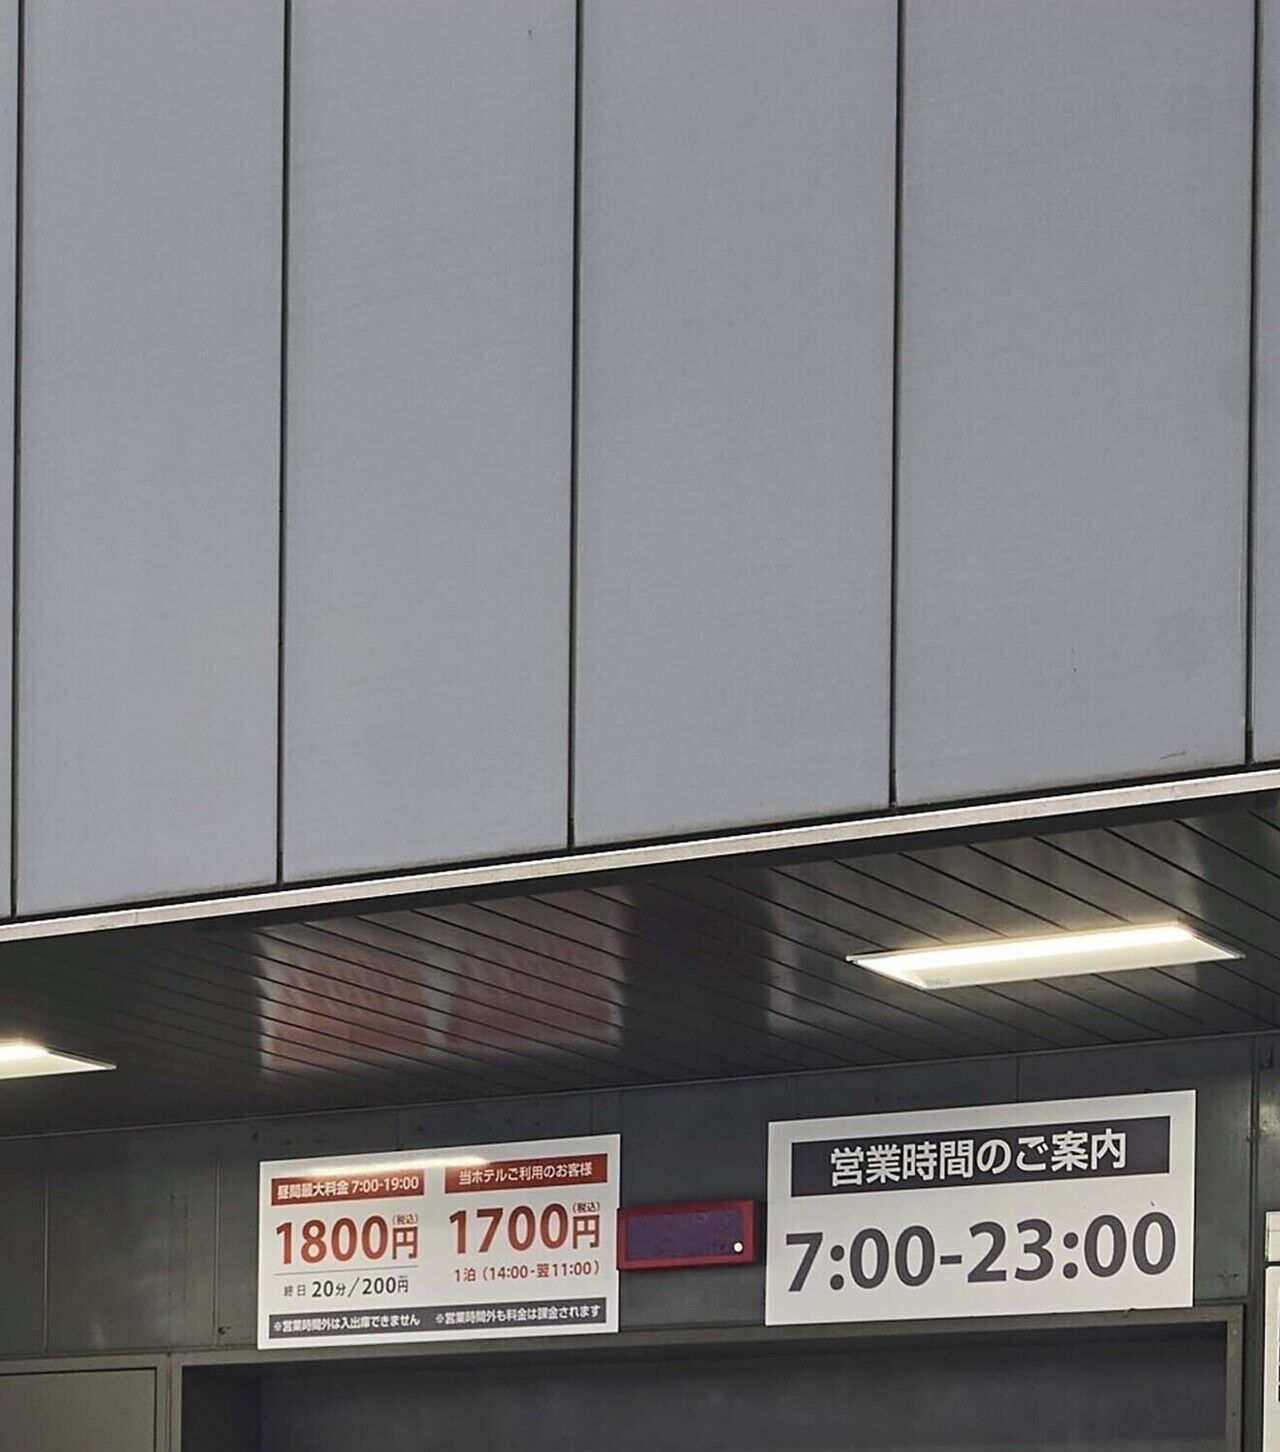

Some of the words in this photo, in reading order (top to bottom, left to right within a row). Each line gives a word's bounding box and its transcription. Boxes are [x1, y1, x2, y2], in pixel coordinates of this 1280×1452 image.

[830, 1128, 1127, 1186] 営業時間のご案内
[459, 1161, 593, 1185] 当ホテルご利用のお客様
[277, 1181, 349, 1200] 昼間最大料金
[352, 1176, 419, 1194] 7:00-19:00
[785, 1210, 1176, 1293] 7:00-23:00
[455, 1267, 476, 1282] 1泊
[273, 1313, 421, 1335] ※営業時間外は入出庫できません
[435, 1304, 601, 1325] ※営業時間外も料金は課金されます
